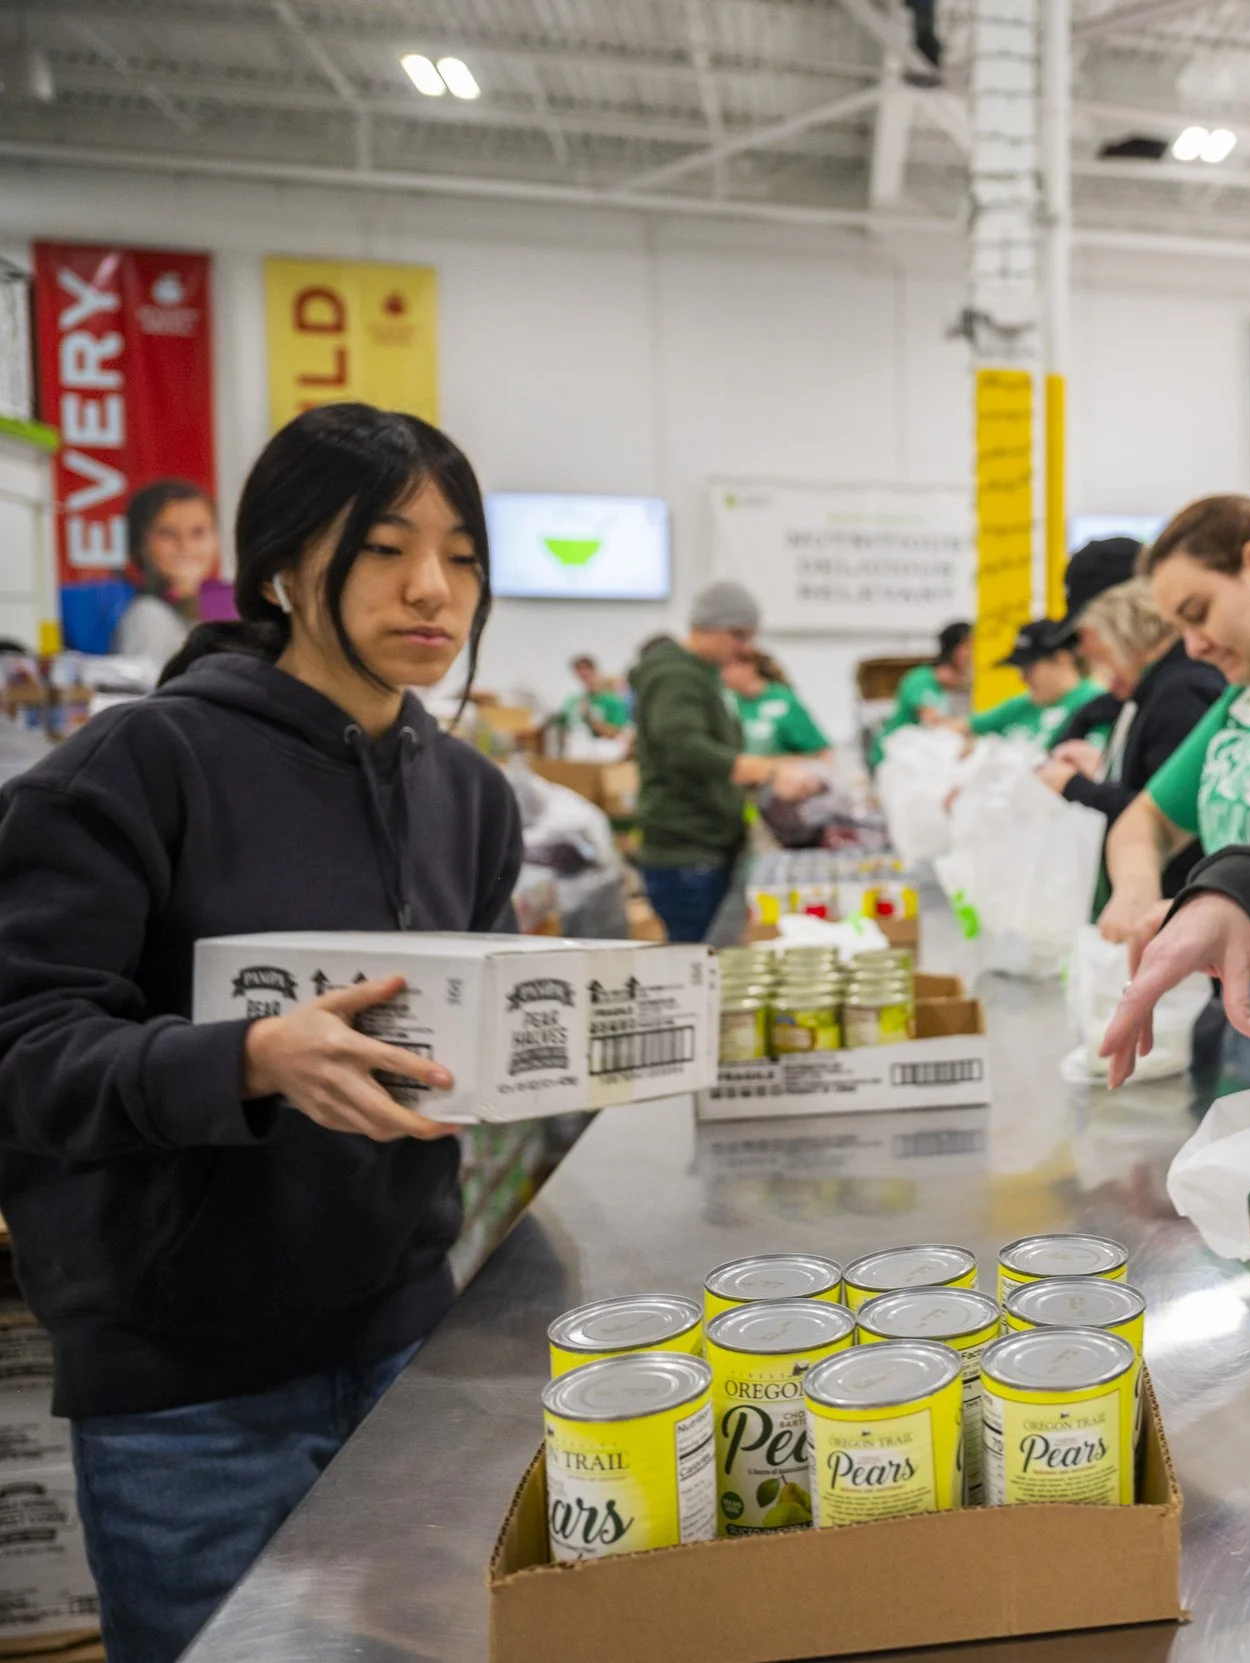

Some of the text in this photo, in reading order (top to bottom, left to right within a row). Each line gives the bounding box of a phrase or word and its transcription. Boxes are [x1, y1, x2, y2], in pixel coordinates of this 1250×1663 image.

[295, 285, 348, 411] LD
[58, 263, 128, 570] EVERY
[563, 1450, 630, 1471] TRAIL
[827, 1450, 918, 1490] Pears
[1020, 1433, 1109, 1473] Pears
[551, 1497, 634, 1545] ars
